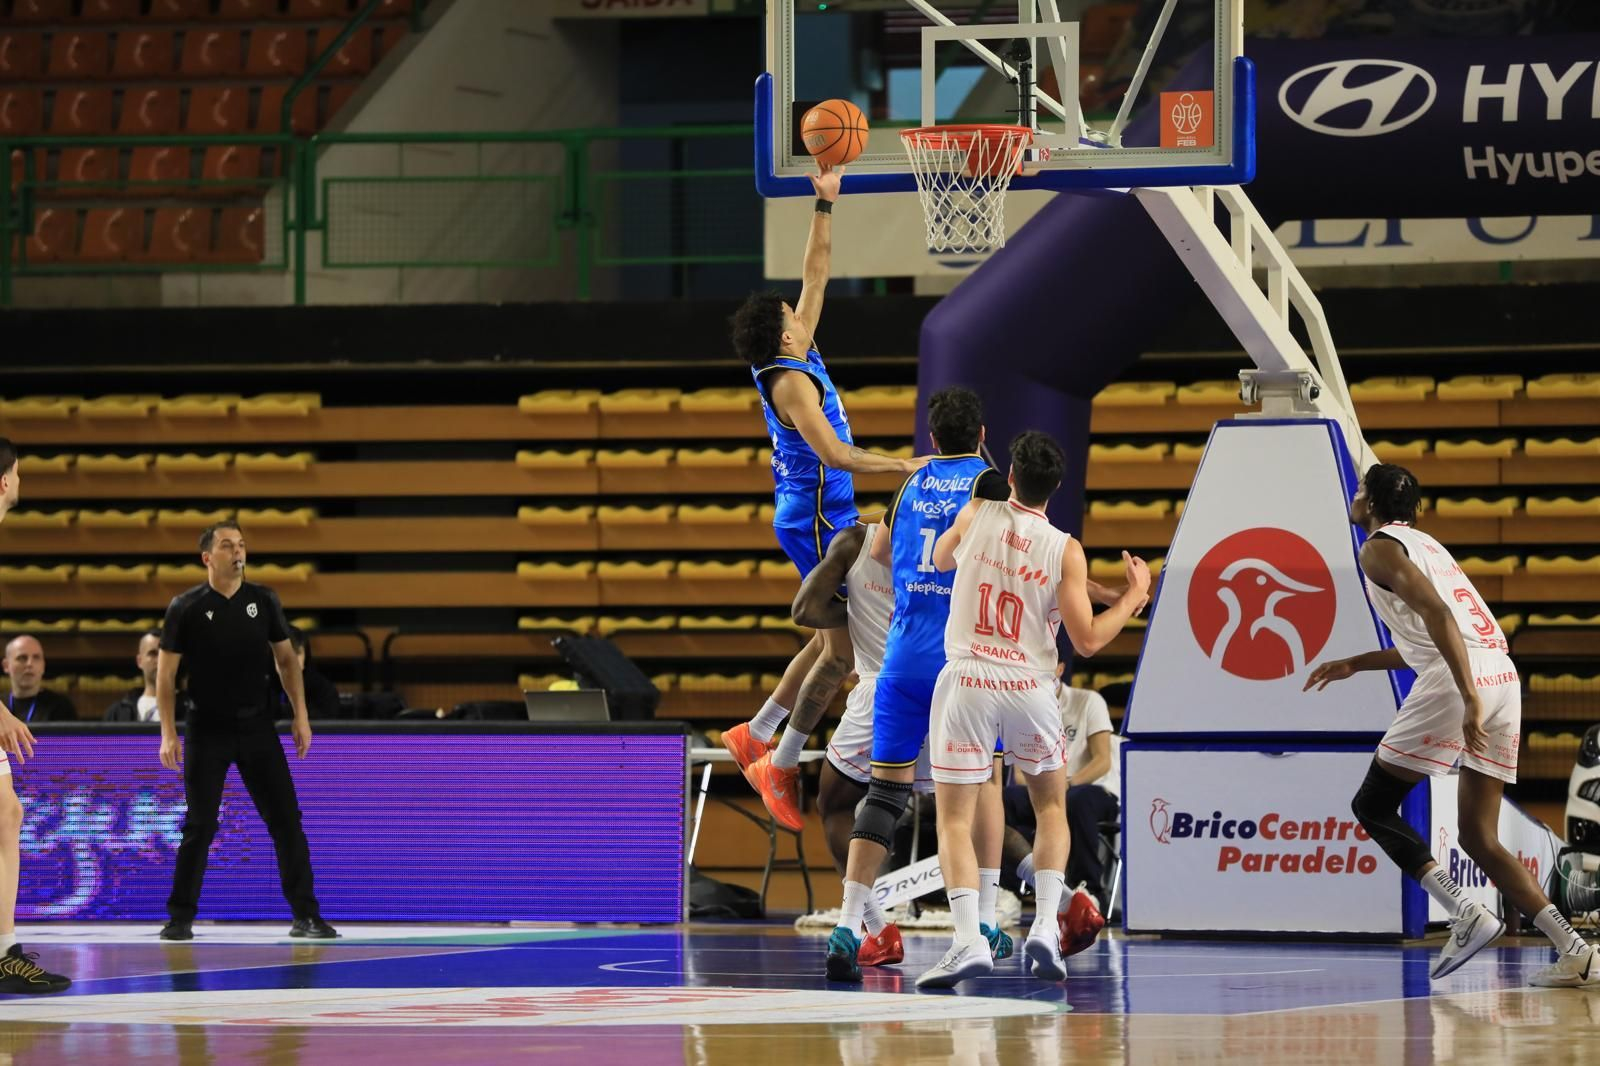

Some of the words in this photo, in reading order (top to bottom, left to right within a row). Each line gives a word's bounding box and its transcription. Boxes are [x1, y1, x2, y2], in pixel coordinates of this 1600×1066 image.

[1462, 61, 1600, 122] HY
[912, 500, 941, 514] MGS
[975, 582, 1024, 643] 10
[1453, 588, 1495, 636] 3
[1217, 846, 1378, 874] Paradelo
